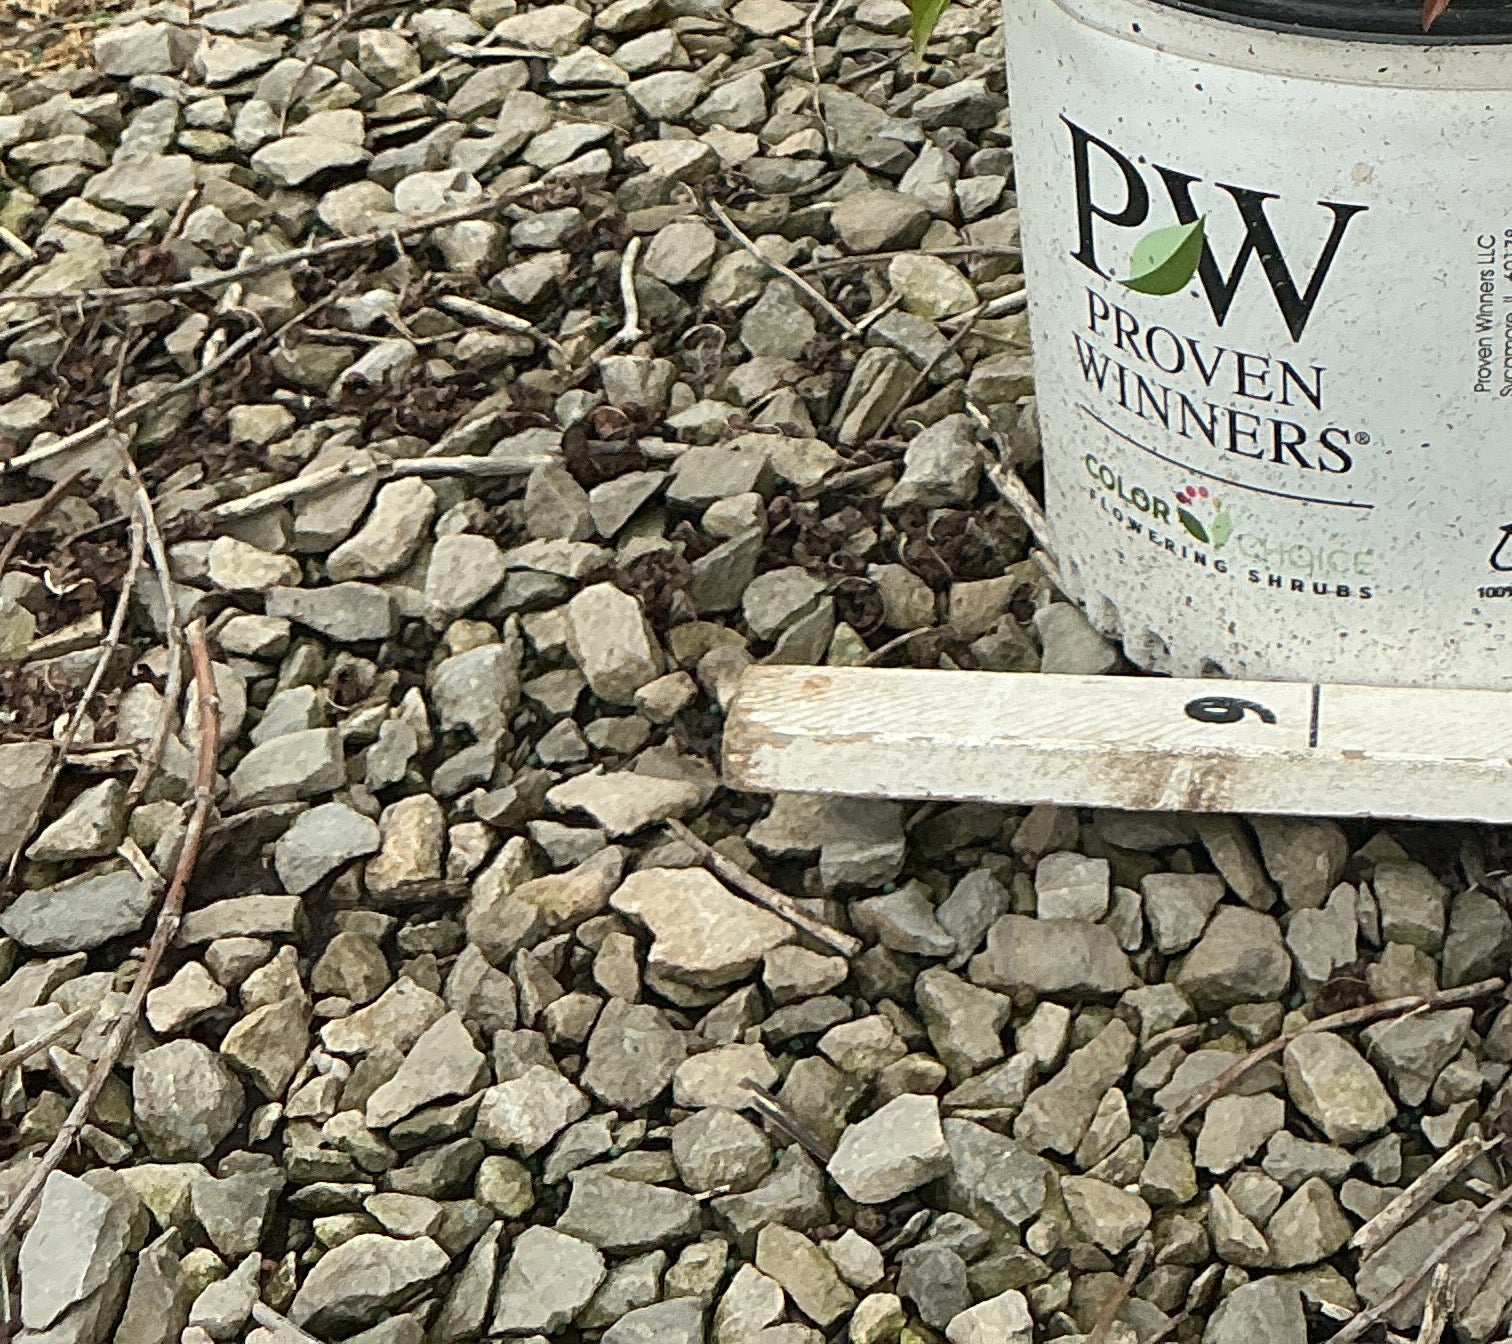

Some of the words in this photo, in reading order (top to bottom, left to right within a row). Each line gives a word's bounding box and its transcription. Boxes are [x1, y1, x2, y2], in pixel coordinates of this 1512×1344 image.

[1059, 113, 1370, 343] PW
[1477, 234, 1496, 264] LLC
[1475, 269, 1495, 333] Winners
[1085, 286, 1328, 411] PROVEN
[1474, 337, 1493, 393] Proven
[1084, 453, 1171, 525] COLOR
[1090, 487, 1229, 574] FLOWERING
[1248, 569, 1374, 600] SHRUBS
